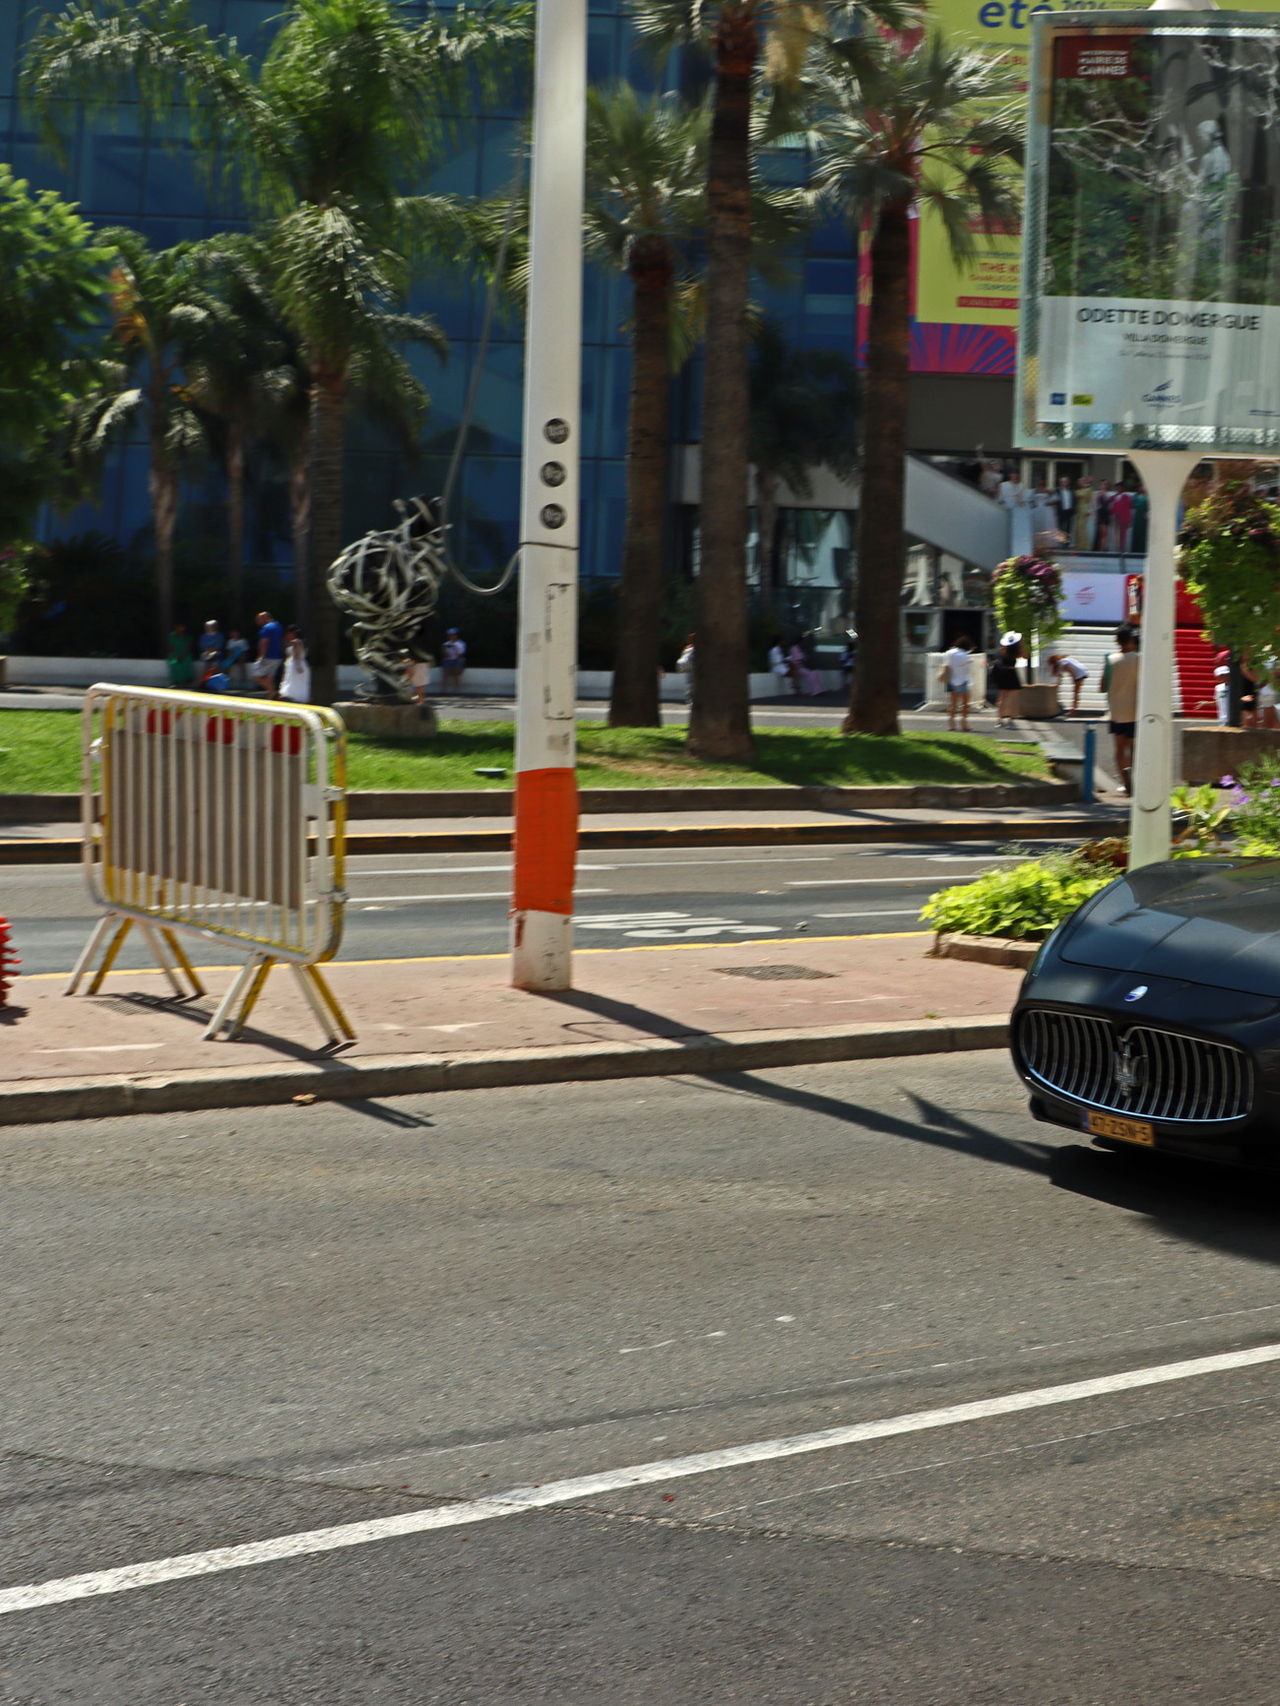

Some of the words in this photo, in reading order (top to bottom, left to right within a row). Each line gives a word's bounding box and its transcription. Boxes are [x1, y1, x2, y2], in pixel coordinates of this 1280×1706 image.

[1077, 65, 1128, 75] CANNES
[1077, 308, 1150, 324] ODETTE
[1153, 310, 1260, 330] DOMERGUE
